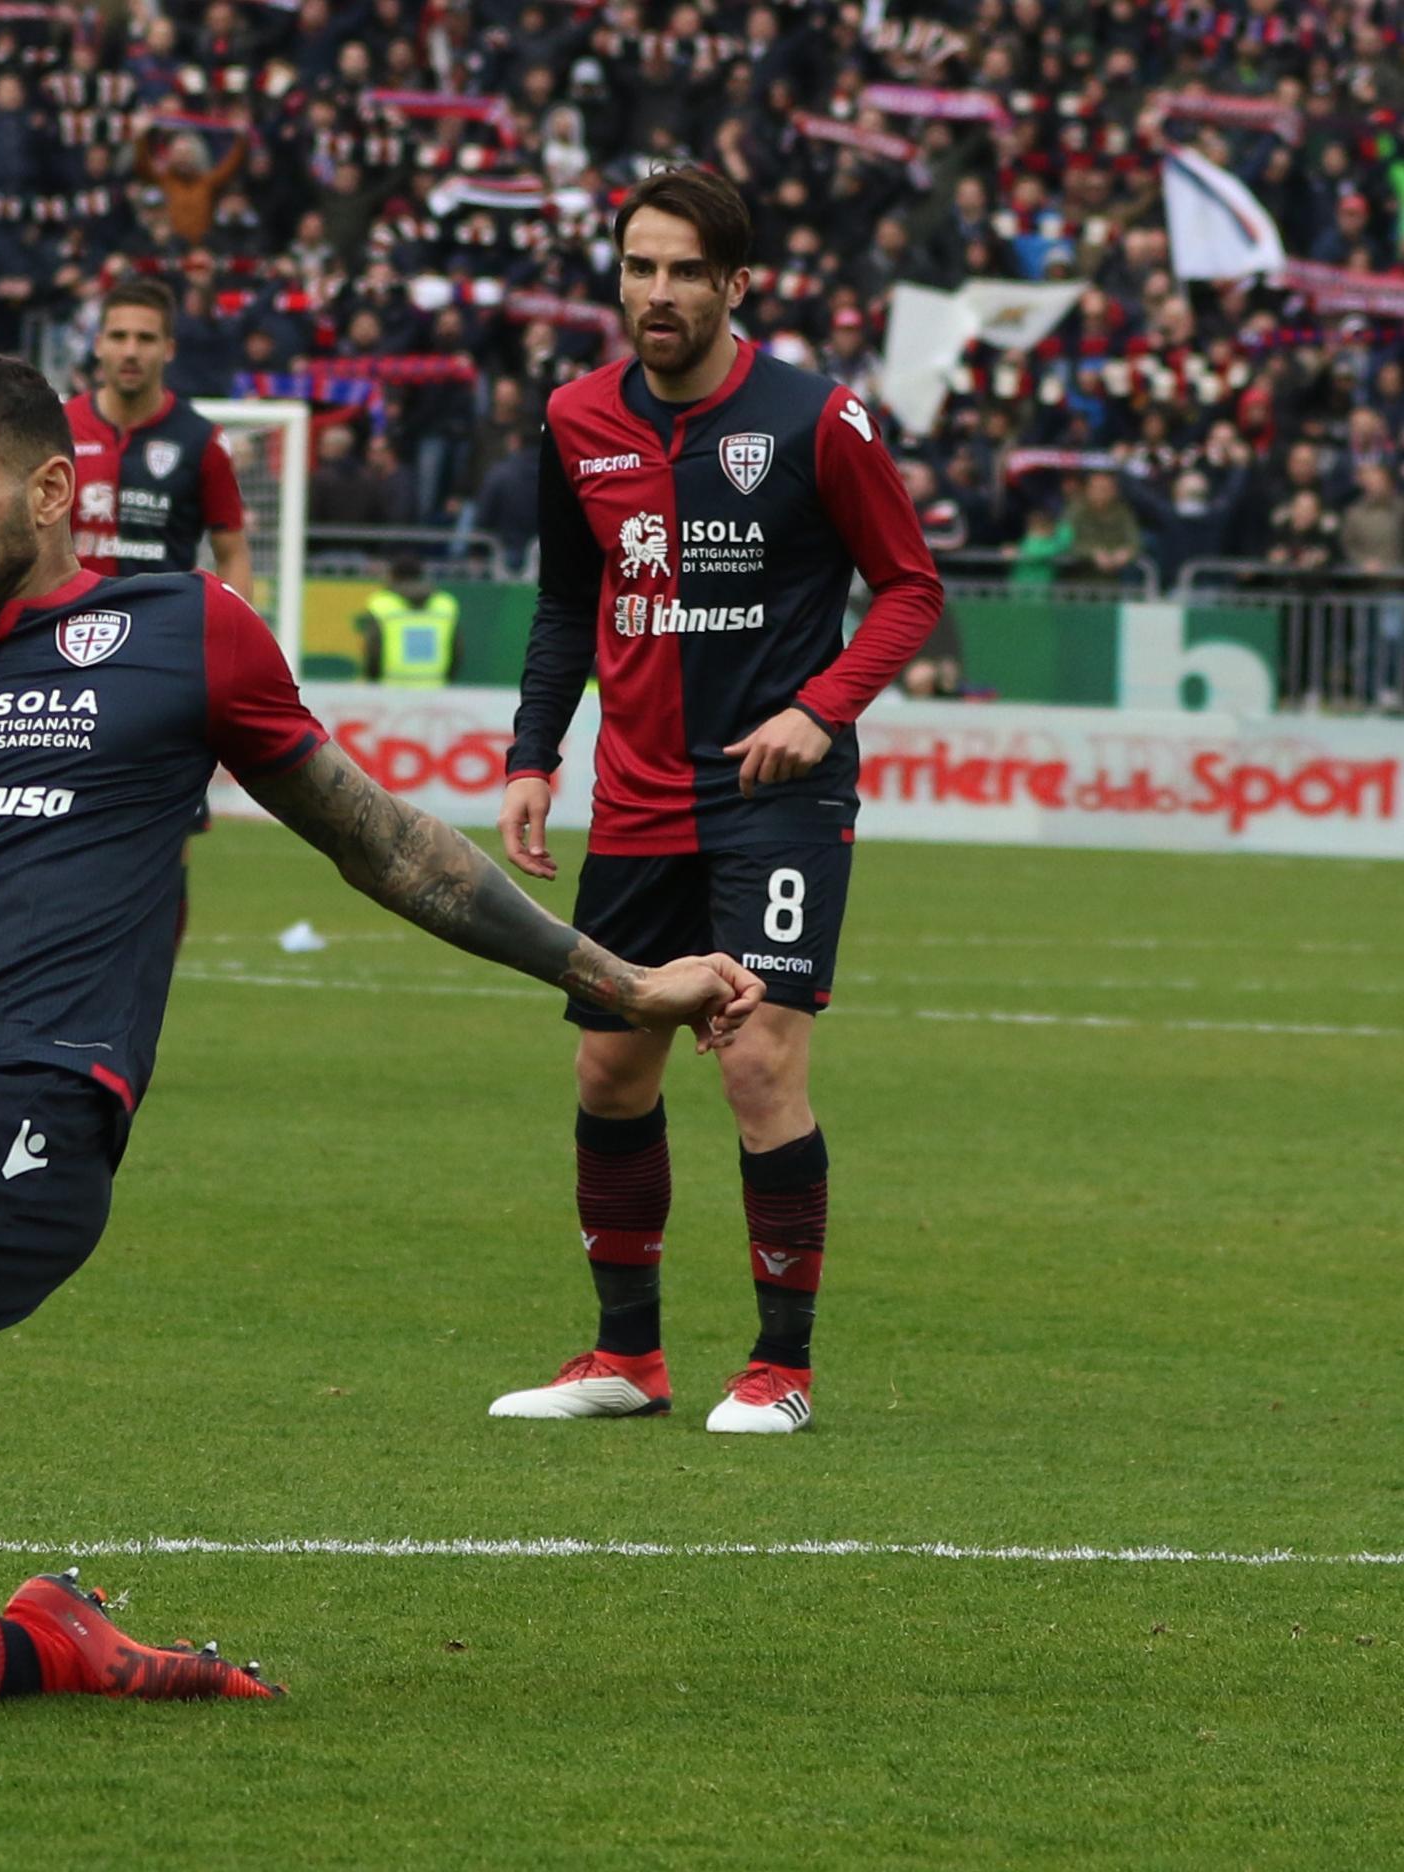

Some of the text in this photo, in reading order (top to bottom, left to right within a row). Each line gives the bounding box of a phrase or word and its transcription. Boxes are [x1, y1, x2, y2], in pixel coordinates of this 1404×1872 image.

[579, 453, 641, 475] macron
[120, 490, 169, 511] ISOLA
[682, 521, 764, 543] ISOLA
[682, 547, 764, 559] ARTIGIANATO
[682, 560, 764, 573] DI SARDEGNA
[68, 613, 121, 625] CAGLIARI
[652, 594, 764, 635] Ichnusa
[1188, 751, 1400, 836] Sport
[763, 867, 806, 943] 8
[742, 953, 814, 975] macron
